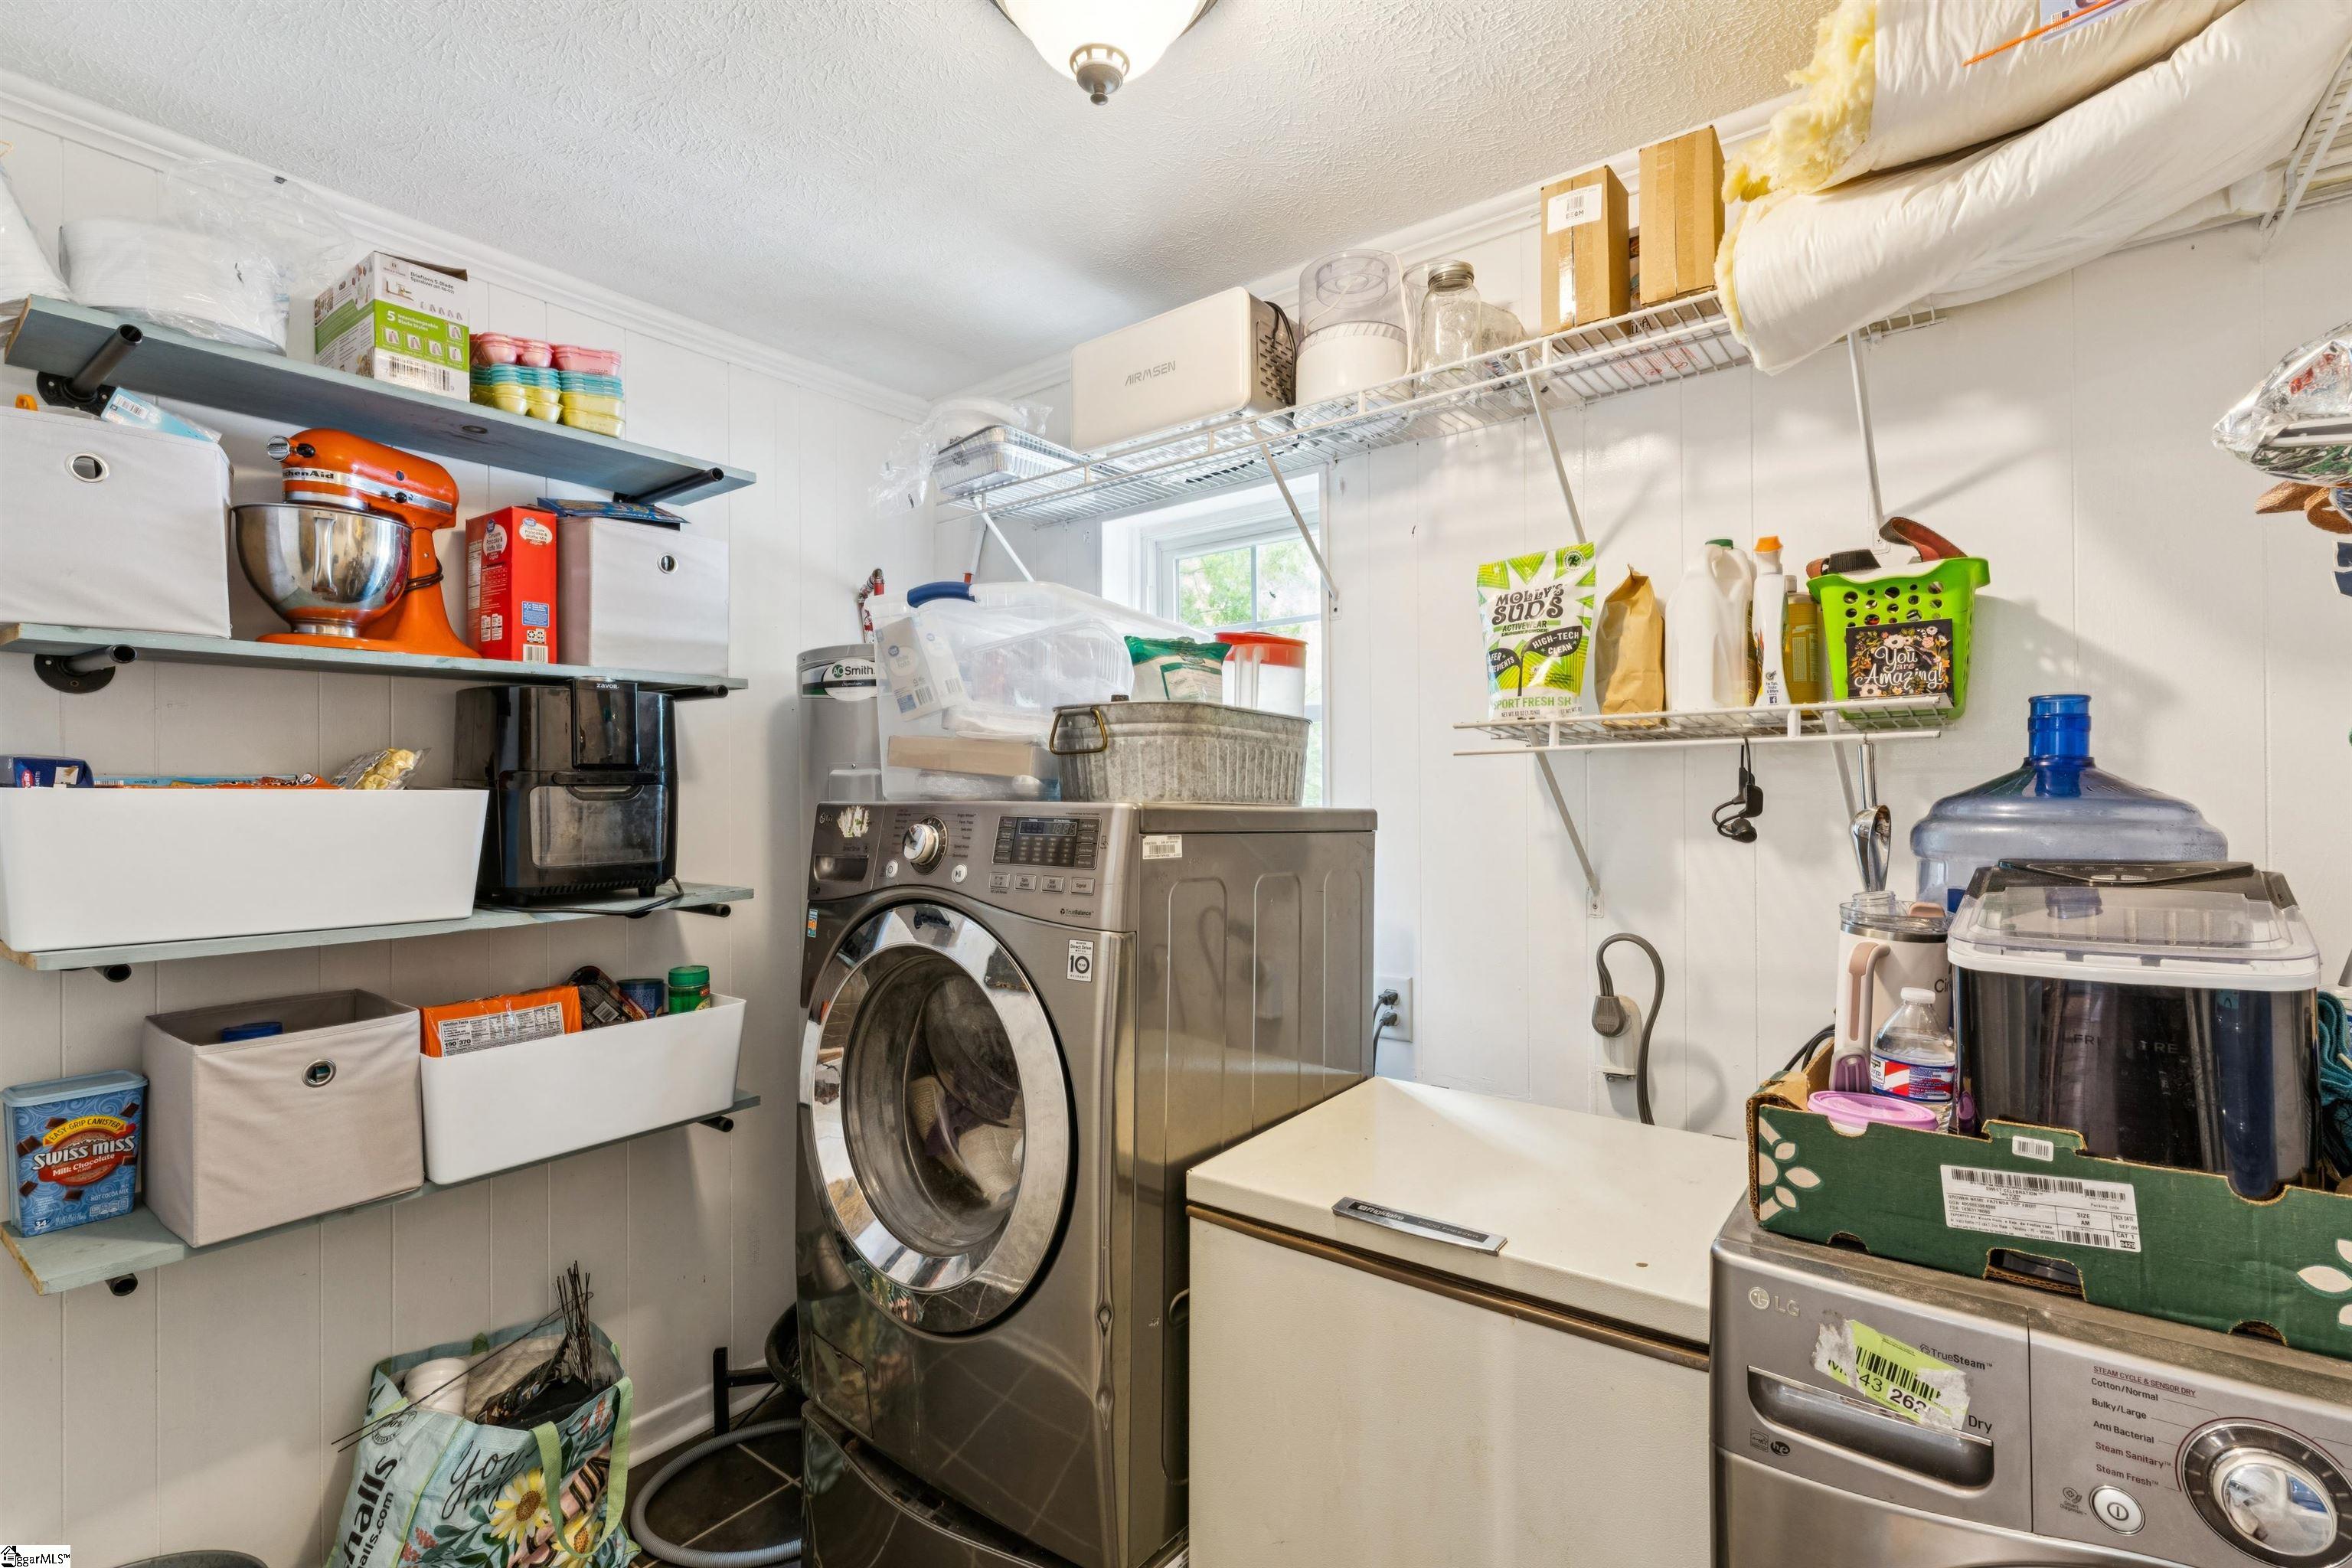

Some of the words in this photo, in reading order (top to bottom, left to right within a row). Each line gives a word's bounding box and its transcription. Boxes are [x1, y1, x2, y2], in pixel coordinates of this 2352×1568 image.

[387, 310, 396, 322] 5
[398, 314, 438, 329] Interchangeable
[1125, 360, 1176, 386] AIRMSEN
[1495, 583, 1564, 606] MOLLY'S
[1491, 596, 1563, 626] SUDS
[1531, 631, 1579, 649] HIGH-TECH
[1547, 643, 1573, 655] CLEAN
[1875, 645, 1918, 673] You
[844, 665, 874, 675] Smith
[1854, 662, 1945, 690] Amazing!
[1522, 697, 1554, 707] FRESH
[1070, 955, 1090, 974] 10
[49, 1119, 86, 1141] EASY-GRIP
[87, 1118, 120, 1129] CANISTER
[53, 1166, 72, 1177] Milk
[73, 1154, 115, 1171] Chocolate
[119, 1188, 129, 1197] MIX
[1775, 1295, 1800, 1317] LG
[2091, 1377, 2158, 1401] Cotton/Normal
[2093, 1366, 2118, 1377] STEAM
[2119, 1373, 2141, 1383] CYCLE
[2150, 1380, 2180, 1393] SENSOR
[2180, 1387, 2197, 1396] DRY
[2092, 1398, 2147, 1419] Bulky/Large
[1968, 1414, 1992, 1434] Dry
[2093, 1421, 2112, 1432] Anti
[2113, 1426, 2154, 1444] Bacterial
[2095, 1442, 2124, 1456] Steam
[2096, 1464, 2125, 1479] Steam
